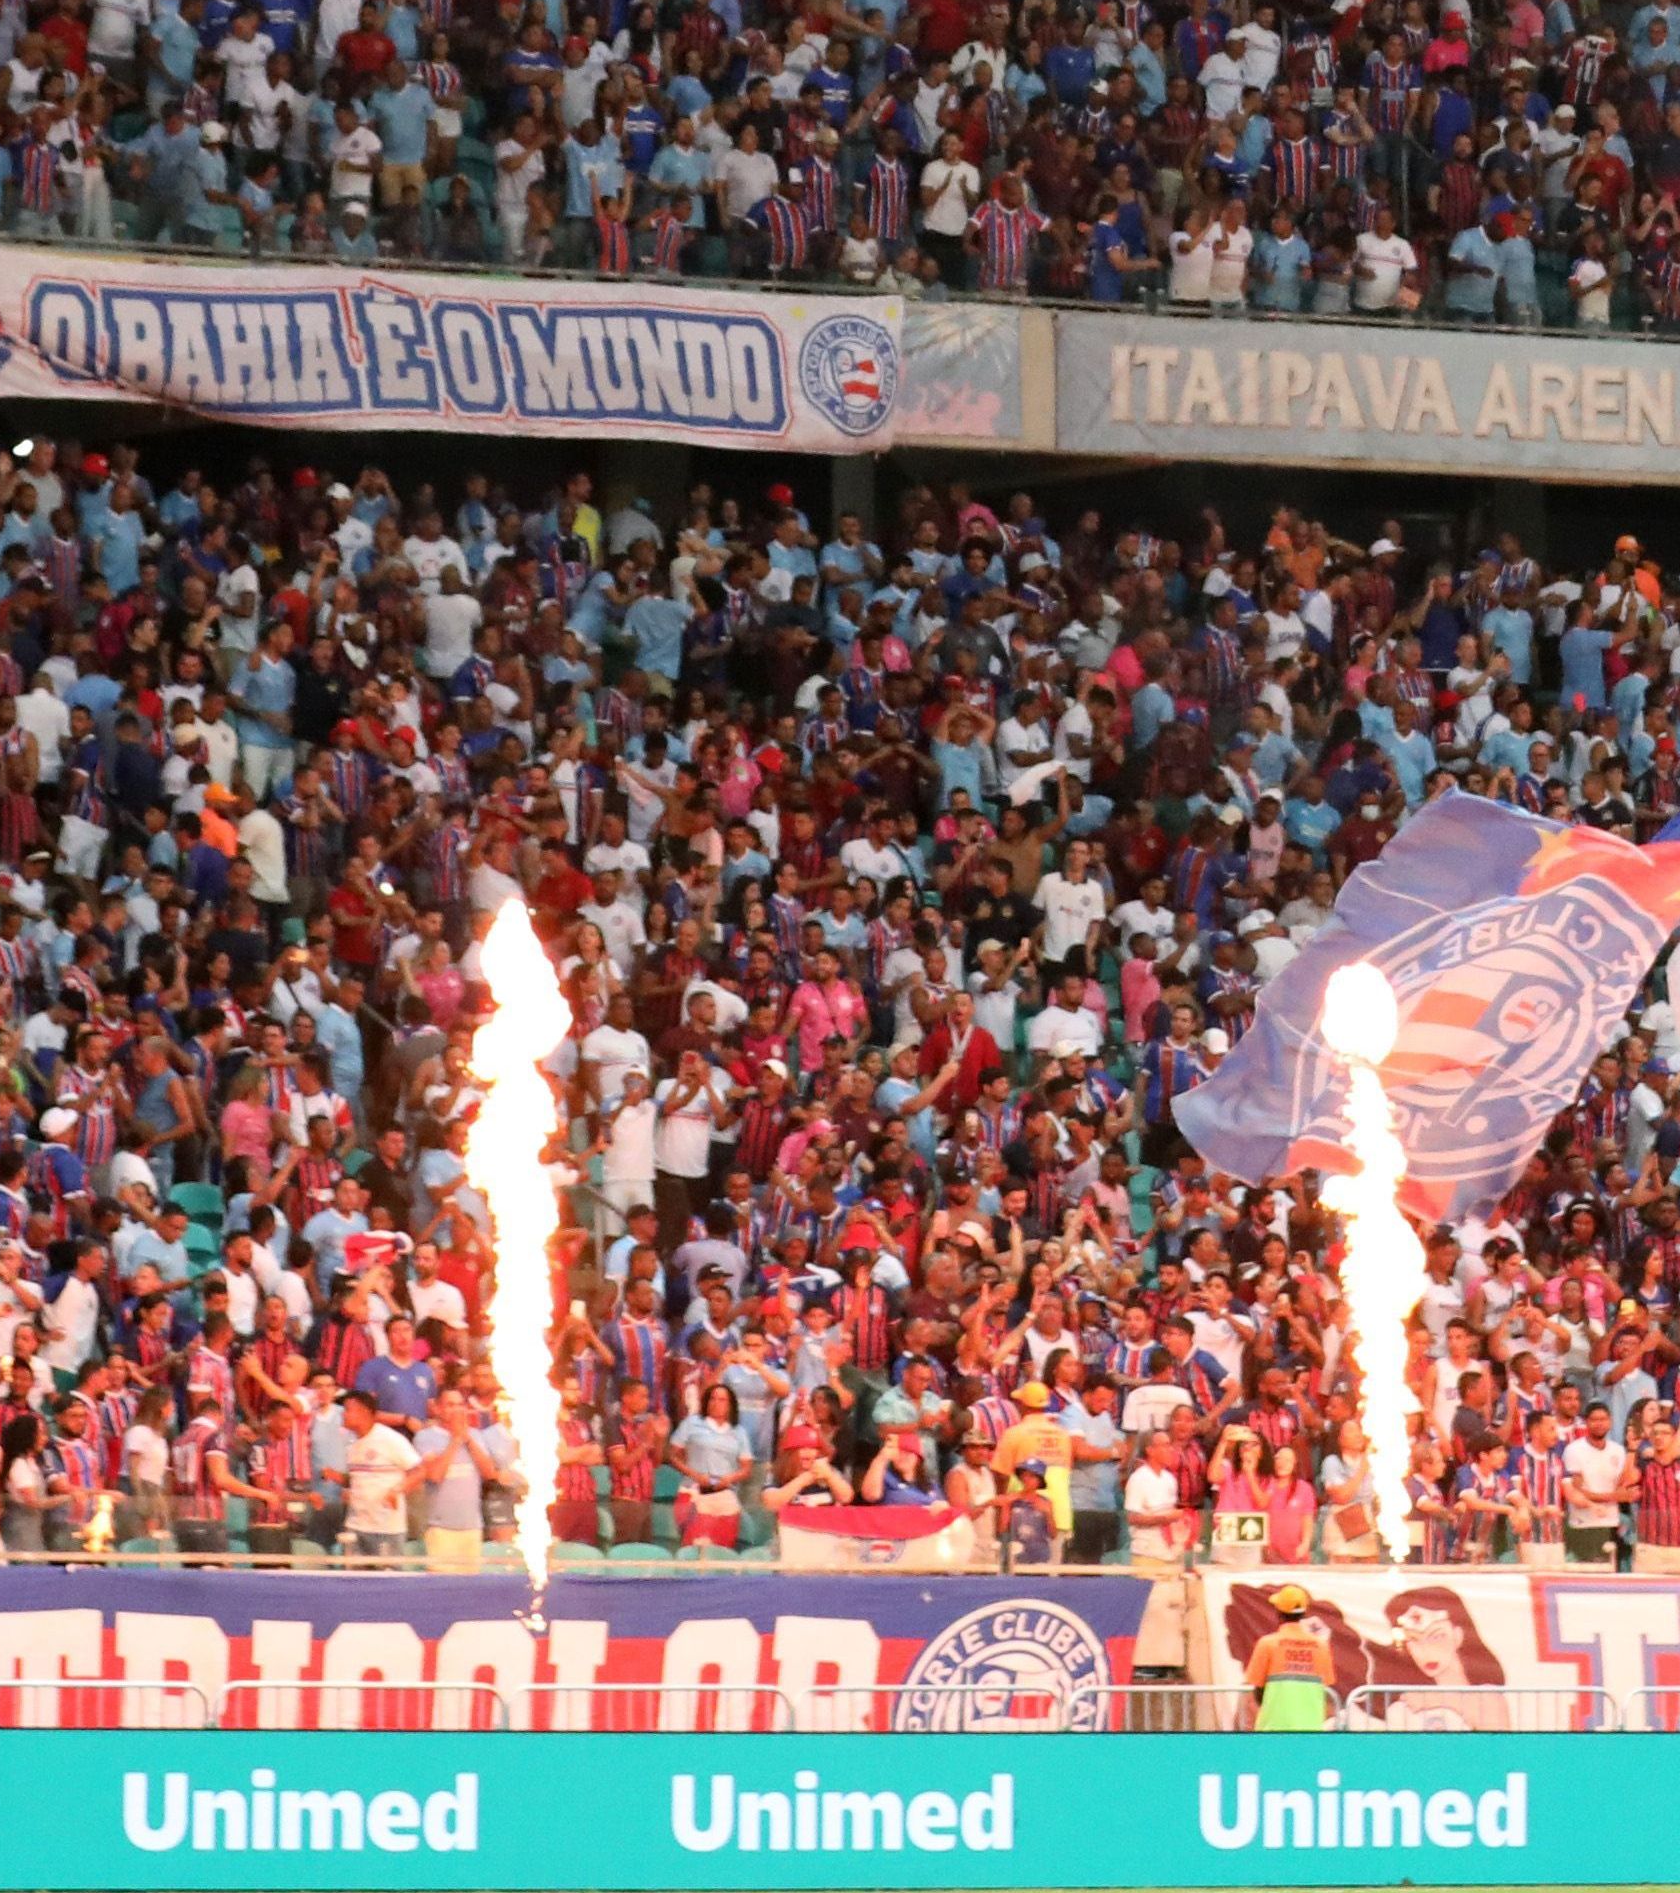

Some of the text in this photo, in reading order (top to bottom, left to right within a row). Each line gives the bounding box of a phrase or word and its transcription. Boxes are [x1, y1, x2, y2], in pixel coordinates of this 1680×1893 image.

[38, 283, 784, 430] O BAHIA É O MUNDO
[1109, 342, 1461, 440] ITAIPAVA
[992, 1611, 1092, 1672] CLUBE
[124, 1769, 479, 1852] Unimed
[671, 1771, 1014, 1852] Unimed
[1198, 1769, 1529, 1851] Unimed
